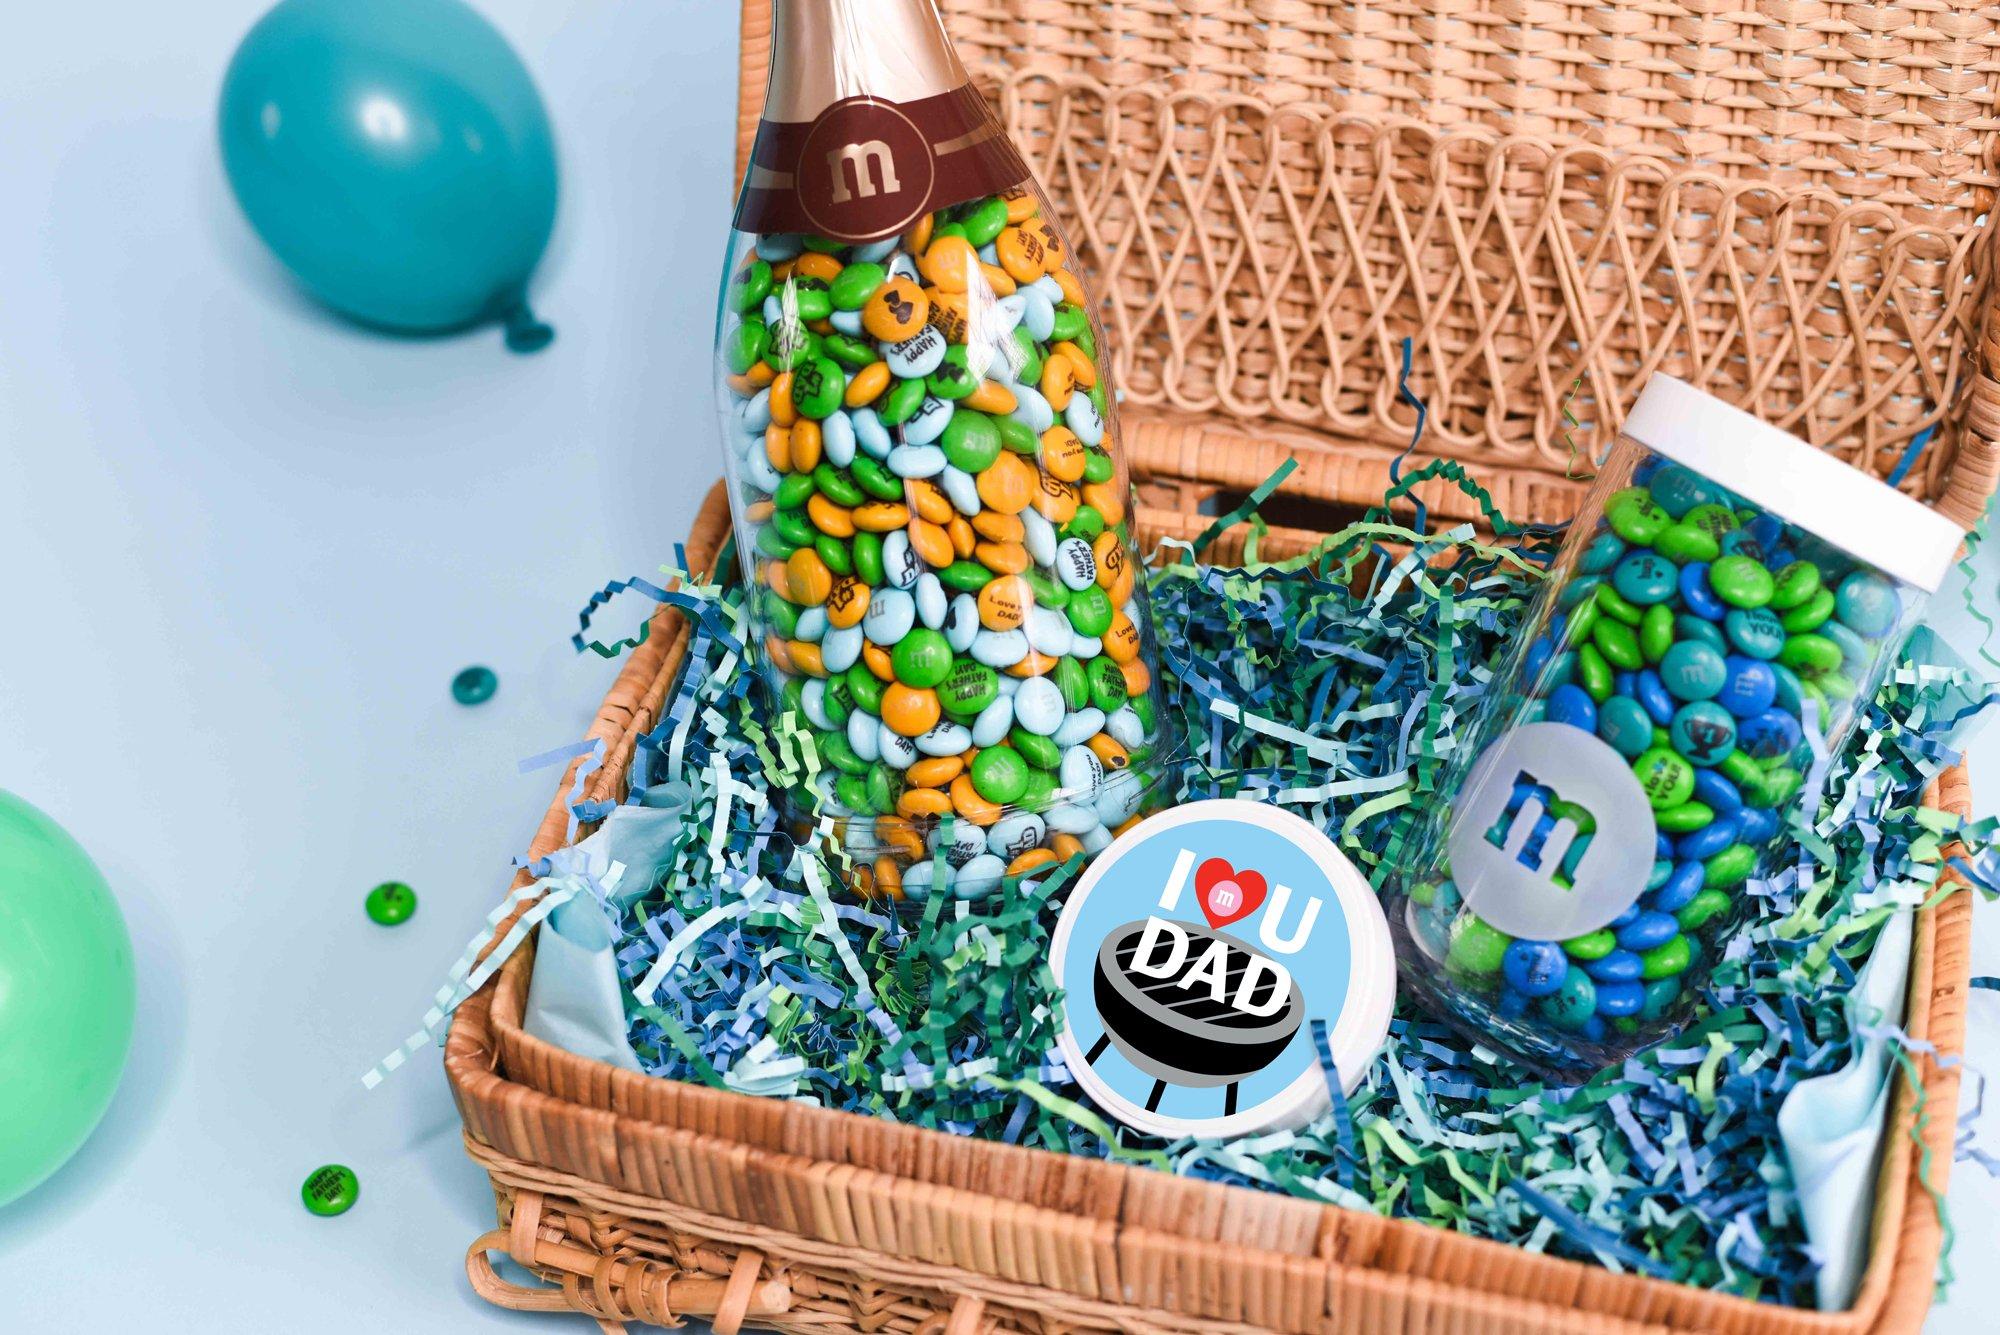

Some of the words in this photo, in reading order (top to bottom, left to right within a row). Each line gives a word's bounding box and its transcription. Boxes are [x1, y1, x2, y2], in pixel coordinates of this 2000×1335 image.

[827, 139, 900, 204] m
[904, 335, 938, 365] HAPPY
[1068, 547, 1087, 578] HAPPY
[989, 595, 1016, 610] Love
[1681, 664, 1709, 685] m
[955, 684, 987, 702] HAPPY
[895, 736, 913, 755] DAY!
[1484, 769, 1597, 891] m
[1158, 848, 1197, 912] I
[1216, 887, 1235, 908] m
[1259, 883, 1323, 954] U
[1129, 915, 1291, 1017] DAD
[308, 1168, 333, 1190] HAPPY
